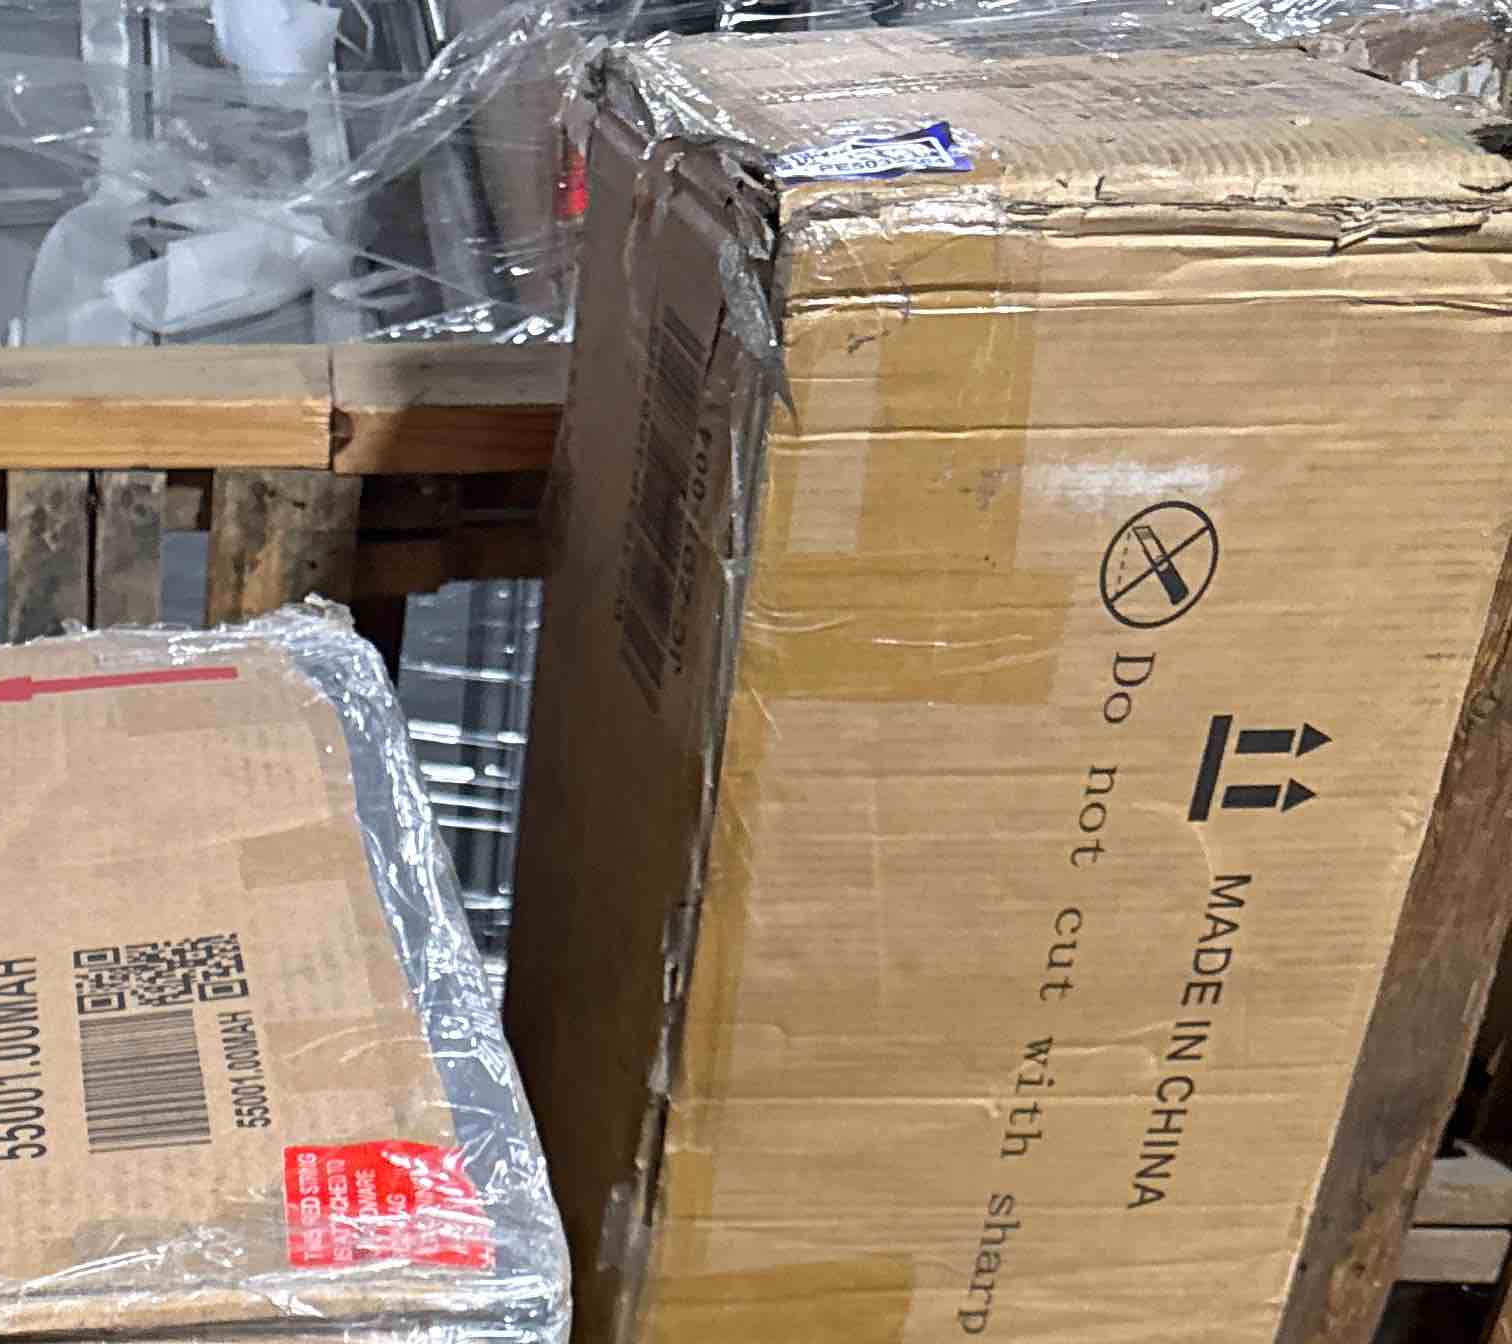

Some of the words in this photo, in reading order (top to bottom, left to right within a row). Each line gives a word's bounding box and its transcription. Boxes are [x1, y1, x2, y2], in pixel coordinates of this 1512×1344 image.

[1102, 650, 1154, 724] Do
[1070, 766, 1120, 868] not
[1040, 907, 1084, 1002] cut
[1181, 874, 1252, 1005] MADE
[220, 1011, 272, 1129] 55001.00MAH
[1000, 1037, 1054, 1159] with
[1171, 1021, 1212, 1060] IN
[1128, 1075, 1194, 1209] CHINA
[959, 1194, 1021, 1337] sharp
